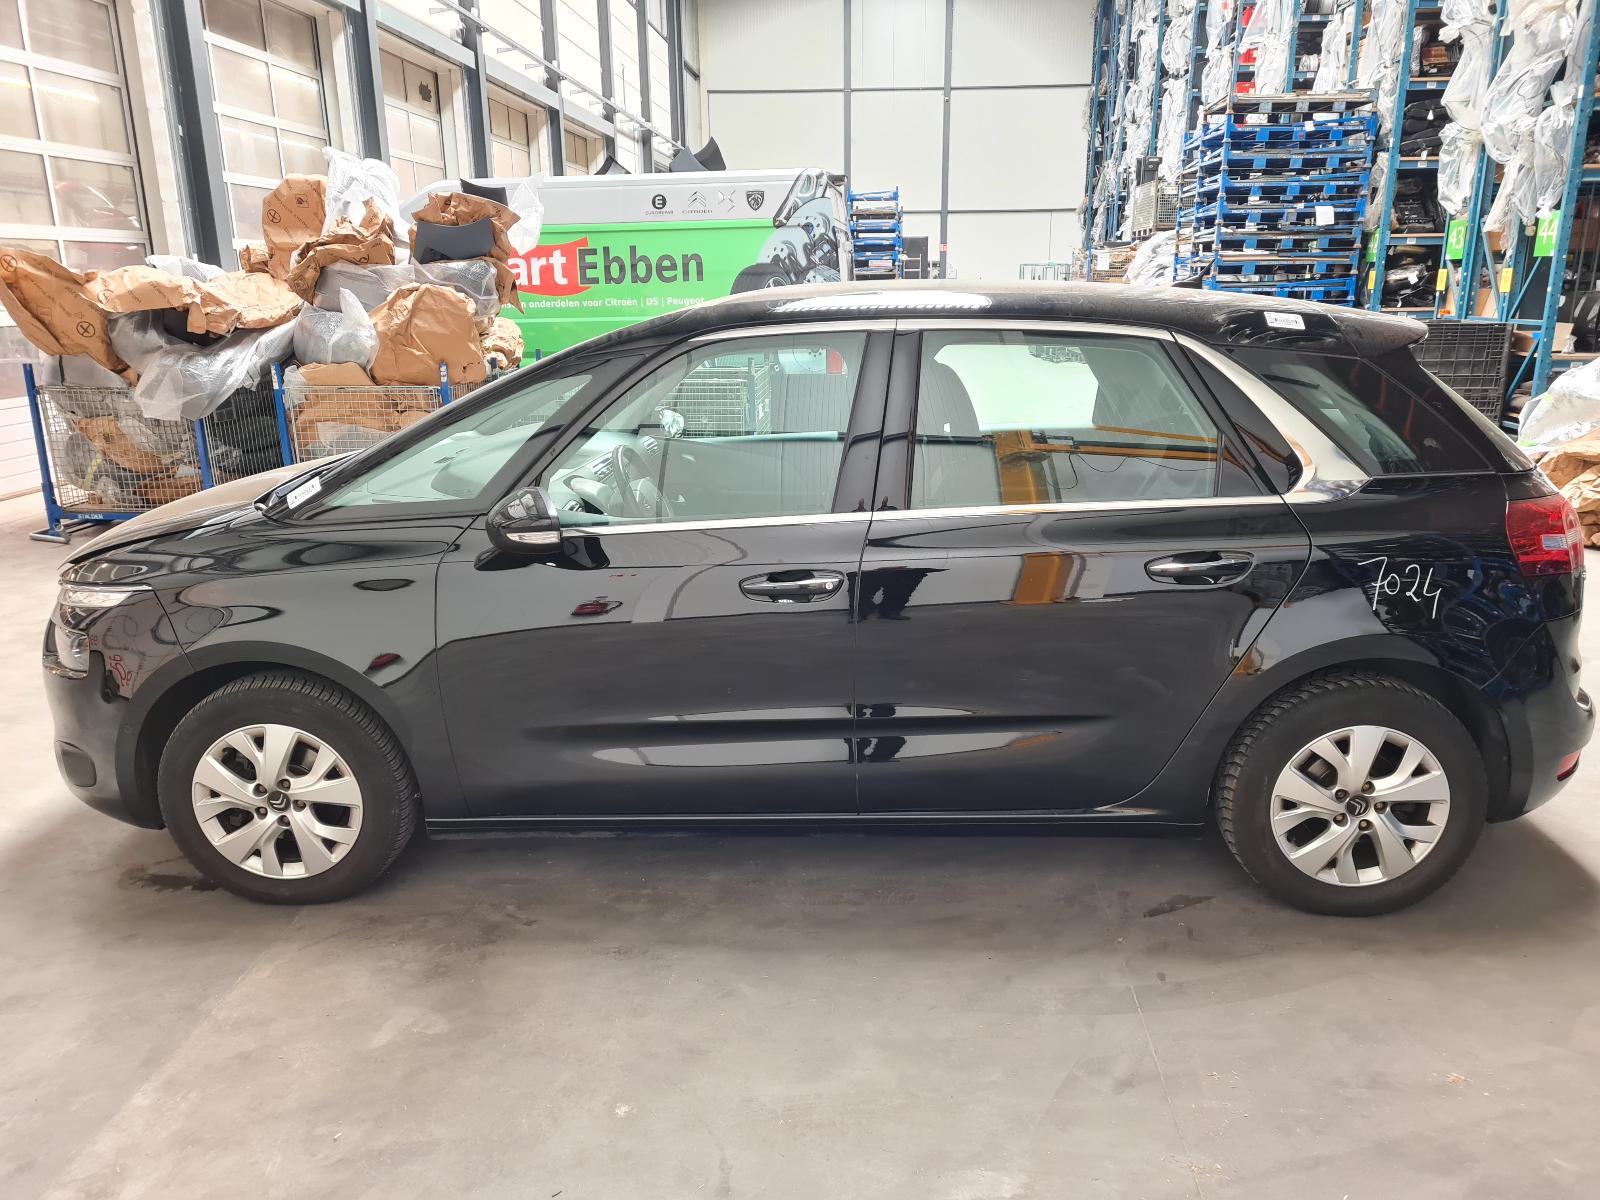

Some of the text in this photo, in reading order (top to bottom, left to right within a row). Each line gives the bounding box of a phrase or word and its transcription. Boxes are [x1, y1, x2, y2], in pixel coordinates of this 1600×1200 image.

[1449, 226, 1465, 250] 43
[1540, 219, 1559, 245] 44
[507, 245, 705, 286] art Ebben
[528, 299, 580, 308] onderdelen
[645, 297, 658, 306] DS
[666, 296, 705, 306] Peugeot
[1357, 556, 1442, 620] 7024
